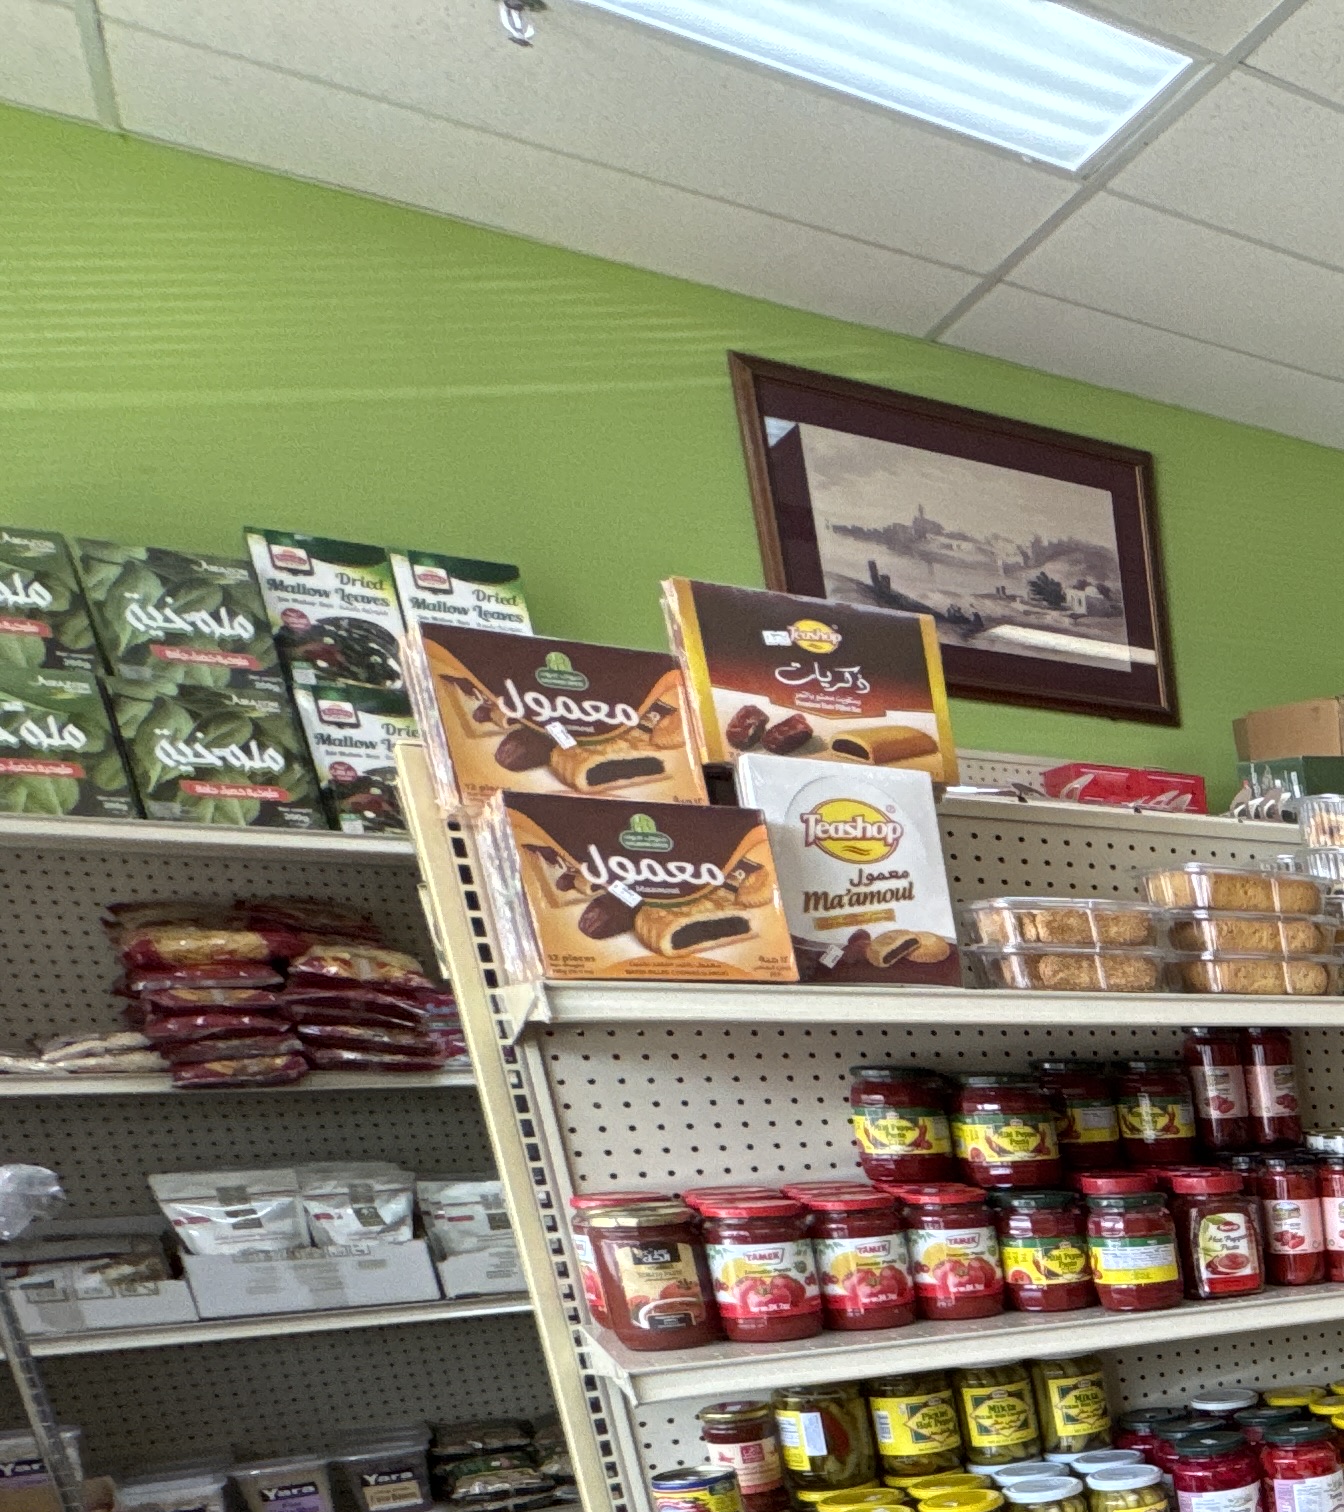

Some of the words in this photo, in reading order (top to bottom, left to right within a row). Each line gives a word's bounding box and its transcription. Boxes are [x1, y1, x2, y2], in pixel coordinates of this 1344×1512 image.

[336, 572, 384, 591] Dried
[267, 578, 331, 599] Mallow
[335, 588, 390, 608] Leaves
[472, 589, 518, 607] Dried
[409, 596, 469, 616] Mallow
[473, 604, 524, 624] Leaves
[774, 661, 871, 694] ذكريات
[498, 678, 640, 727] معمول
[381, 722, 419, 737] Drie
[314, 731, 378, 750] Mallow
[801, 812, 904, 847] Teashop
[580, 843, 726, 886] معمول
[849, 868, 911, 888] معمول
[946, 1233, 979, 1246] TAMEK
[745, 1249, 780, 1262] TAMEK
[857, 1243, 890, 1256] TAMEK
[0, 1462, 44, 1478] Yar
[362, 1470, 414, 1487] Yara
[260, 1484, 317, 1501] Yara
